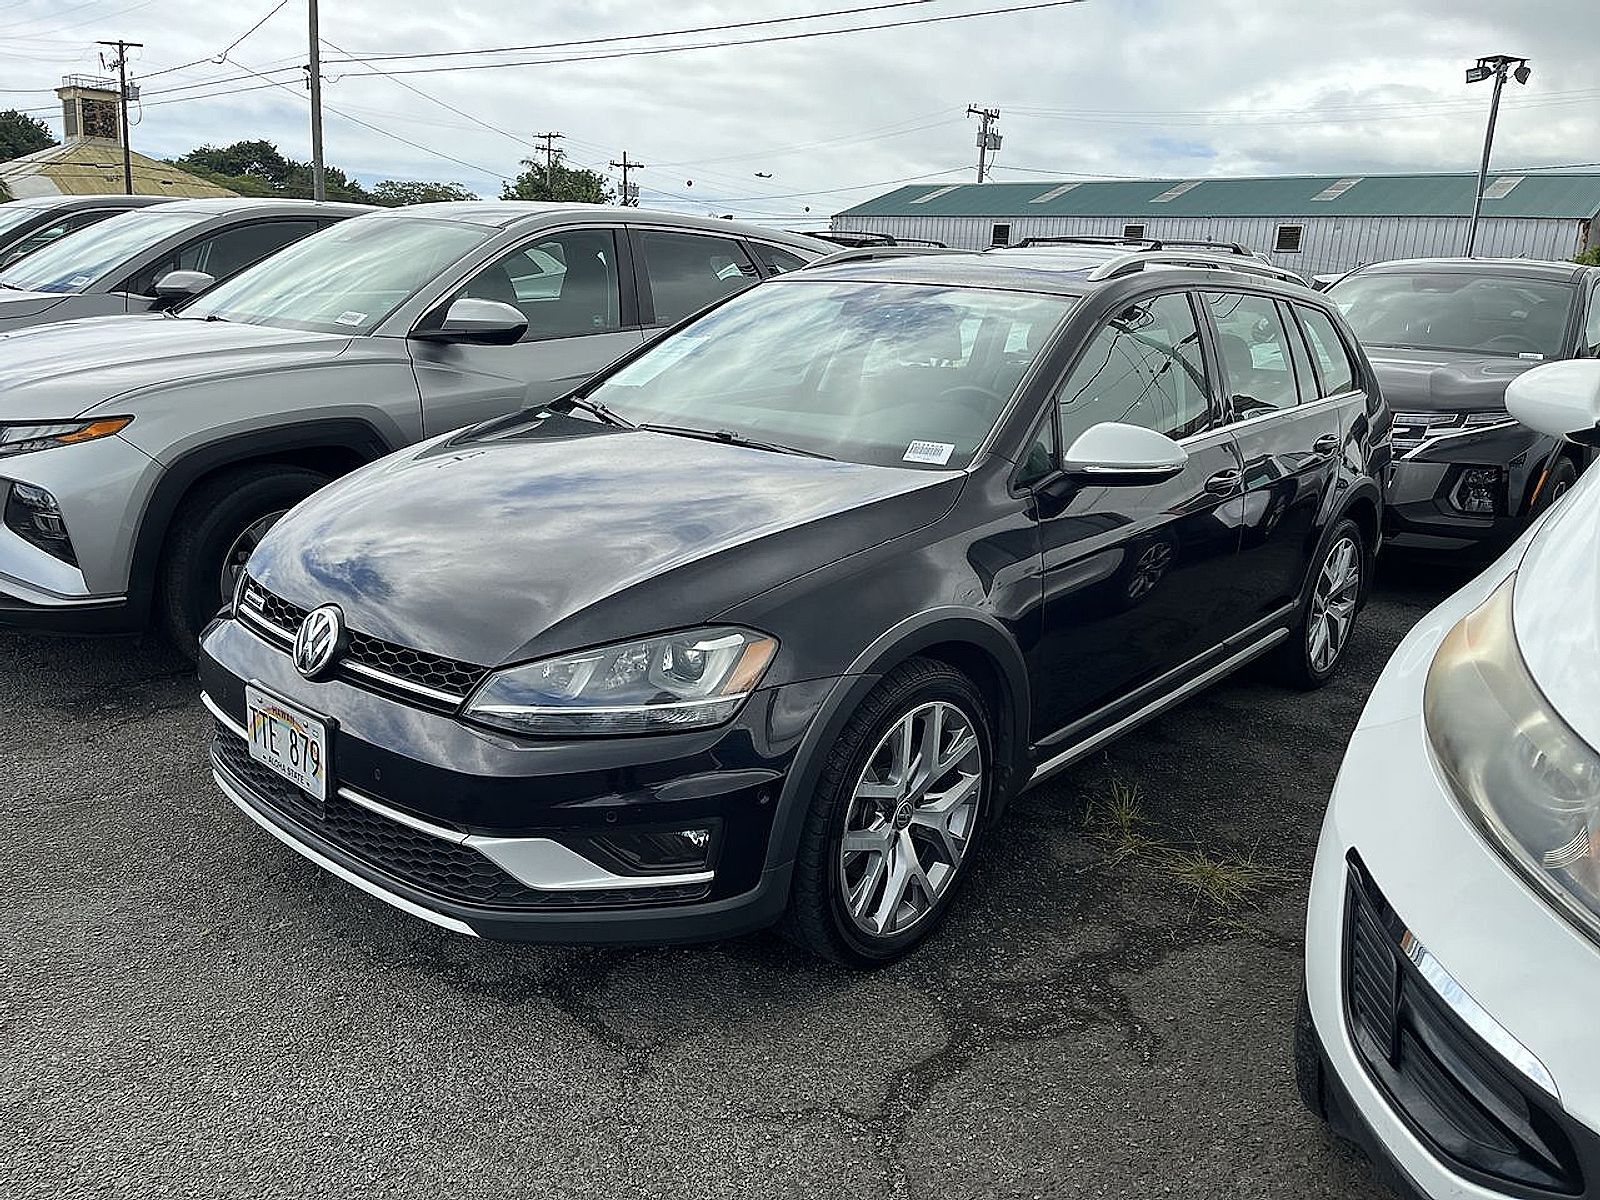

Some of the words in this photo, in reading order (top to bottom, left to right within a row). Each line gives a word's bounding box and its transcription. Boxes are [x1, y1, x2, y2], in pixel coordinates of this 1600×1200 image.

[249, 704, 280, 757] TTE
[290, 728, 320, 777] 879
[287, 766, 305, 785] STATE
